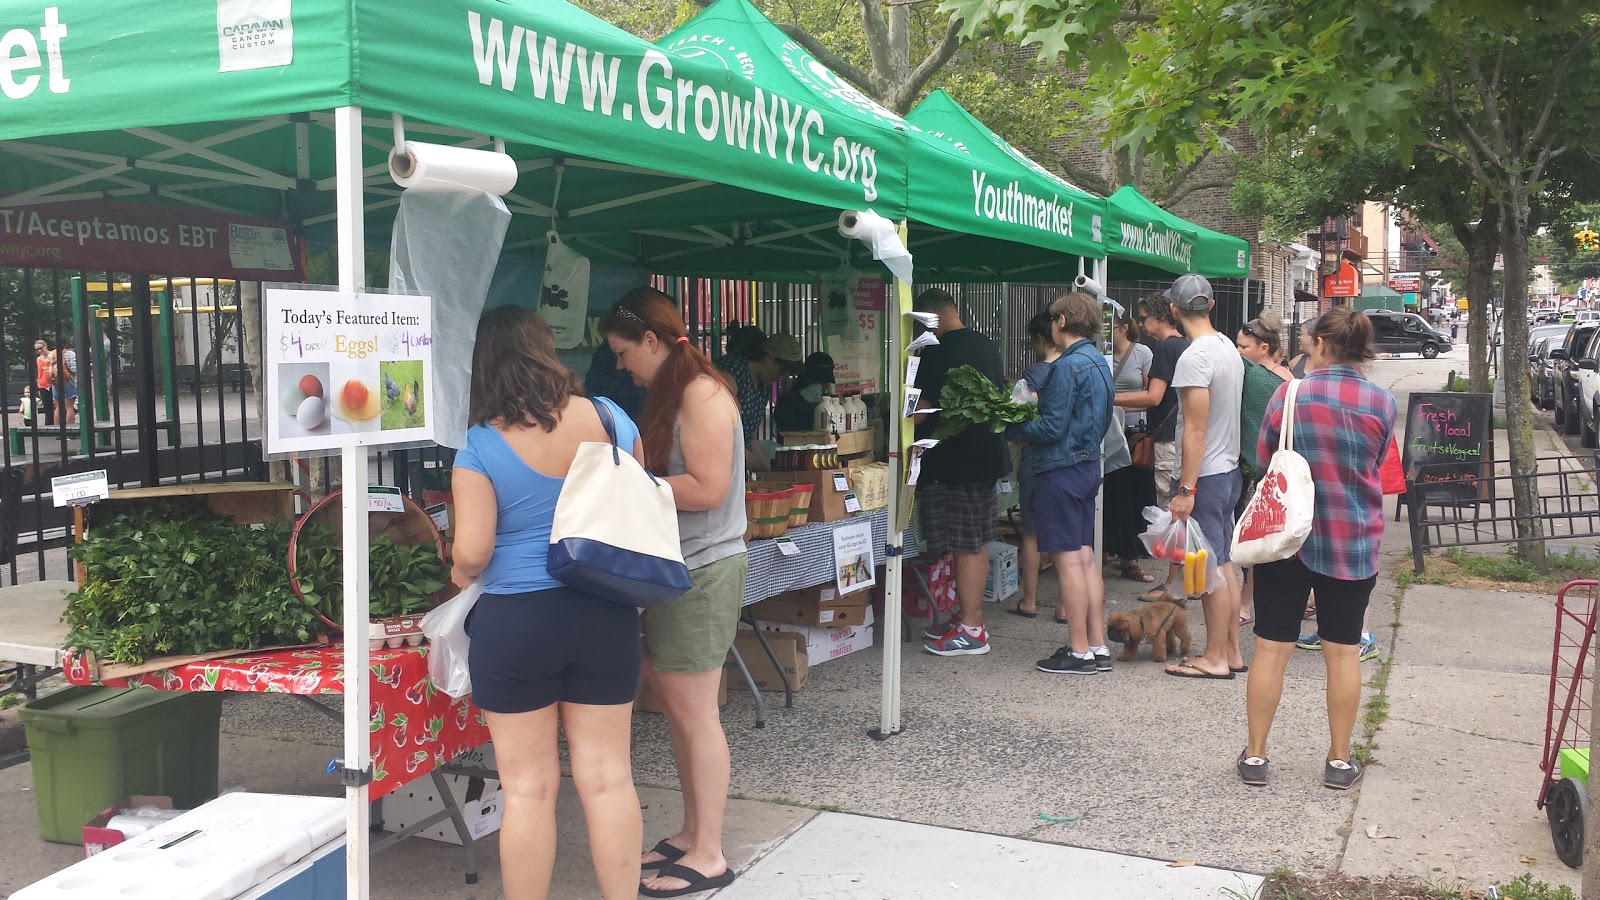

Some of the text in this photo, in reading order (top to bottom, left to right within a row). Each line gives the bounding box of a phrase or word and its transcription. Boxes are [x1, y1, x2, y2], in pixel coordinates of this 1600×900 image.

[223, 19, 284, 37] CARAVAN
[232, 33, 274, 42] CANOPY
[232, 40, 275, 50] CUSTOM
[467, 10, 879, 202] www.GrowNYC.org
[972, 169, 1074, 238] Youthmarket
[179, 223, 218, 250] EBT
[1120, 221, 1193, 272] www.GrowNYC.org
[281, 309, 420, 329] Today's Featured Item:
[858, 313, 875, 330] $5
[334, 334, 379, 359] Eggs!
[834, 371, 861, 379] Recibe
[1417, 403, 1457, 424] Fresh
[1444, 421, 1471, 437] local
[830, 644, 853, 658] TOMATOES
